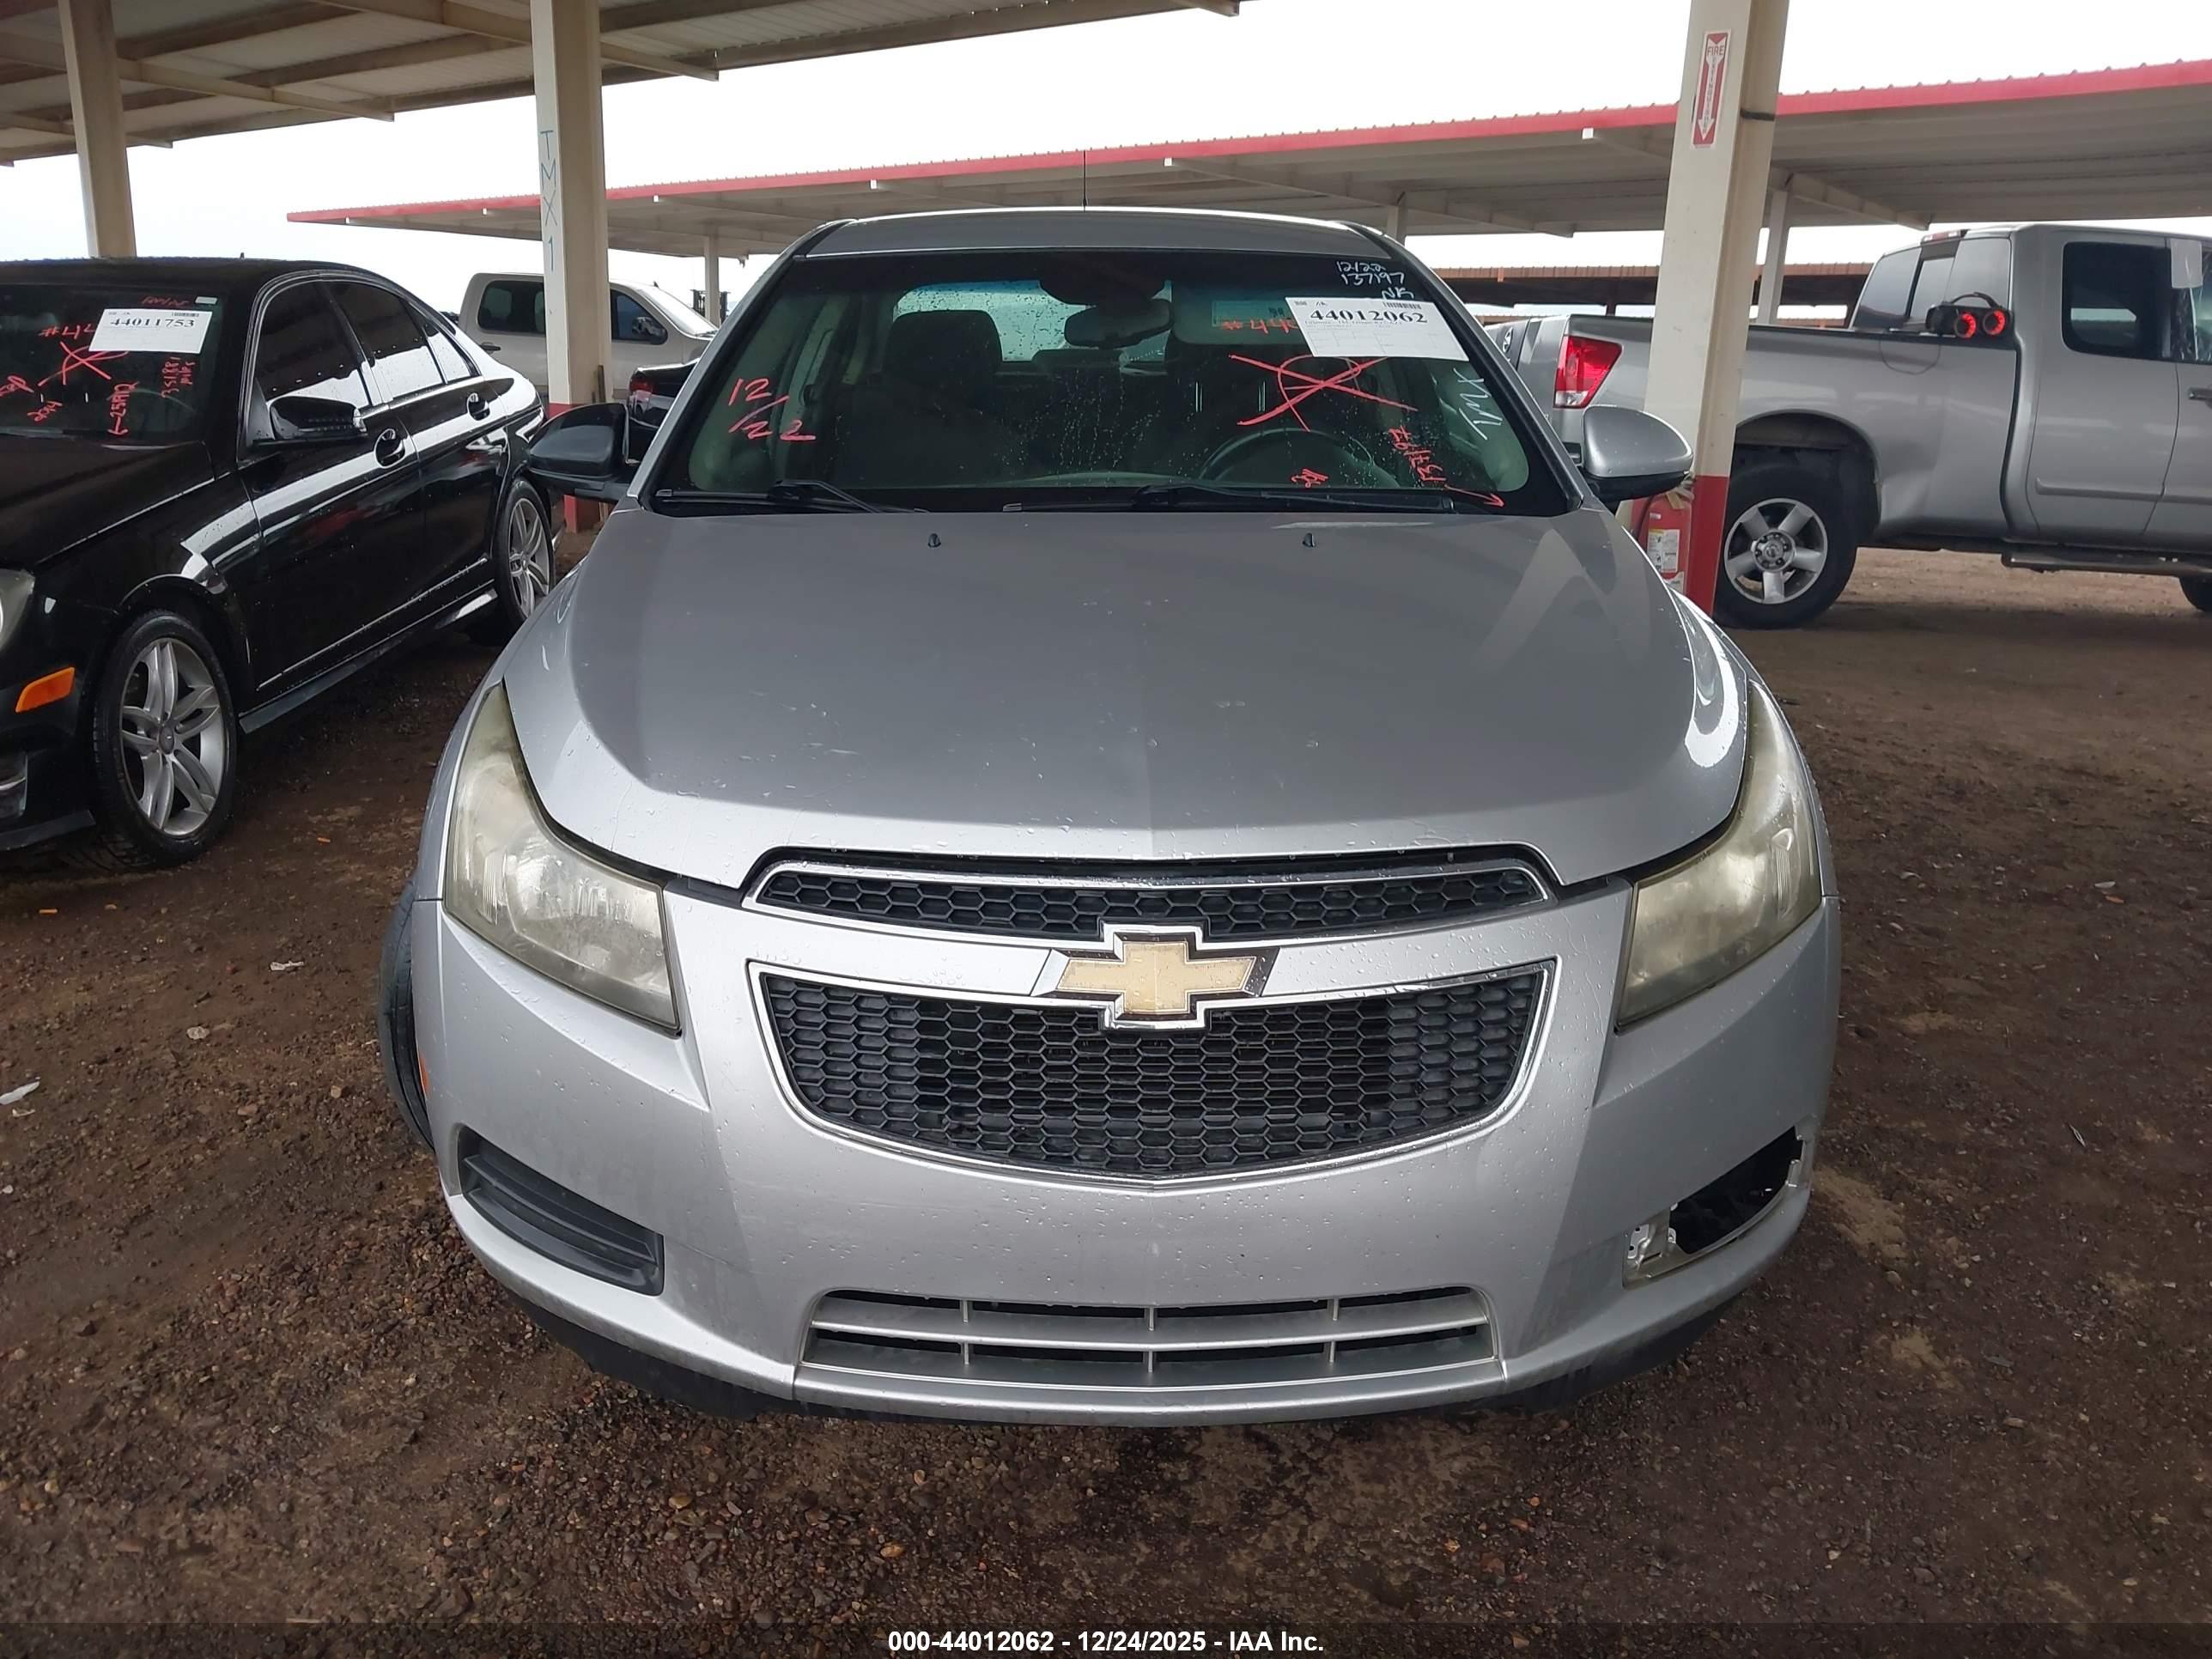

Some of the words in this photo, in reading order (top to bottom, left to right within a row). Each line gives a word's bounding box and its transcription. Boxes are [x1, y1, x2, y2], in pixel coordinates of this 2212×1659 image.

[1706, 46, 1725, 56] FIRE
[1310, 310, 1428, 324] 44012062
[110, 318, 195, 327] 44011753
